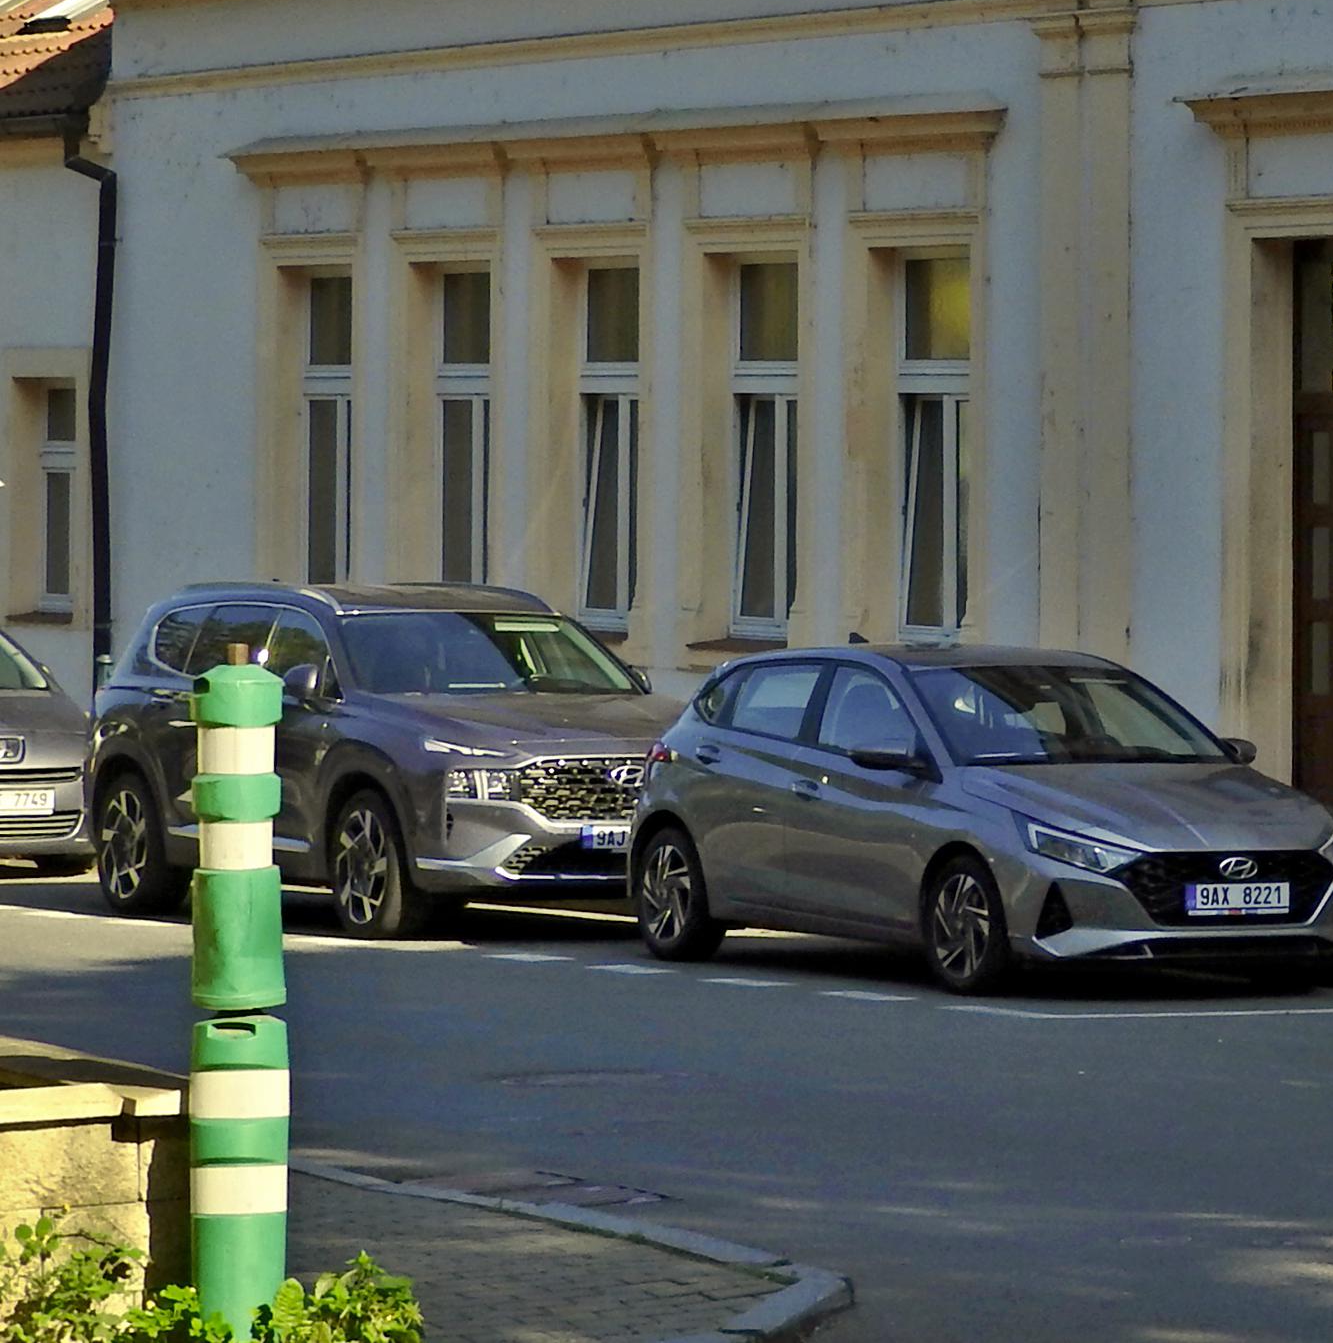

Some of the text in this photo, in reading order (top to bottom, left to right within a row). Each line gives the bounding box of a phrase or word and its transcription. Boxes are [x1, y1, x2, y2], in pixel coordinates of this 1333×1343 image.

[15, 792, 47, 806] 7749
[596, 830, 626, 846] 9AJ
[1200, 886, 1230, 906] 9AX
[1243, 885, 1281, 905] 8221
